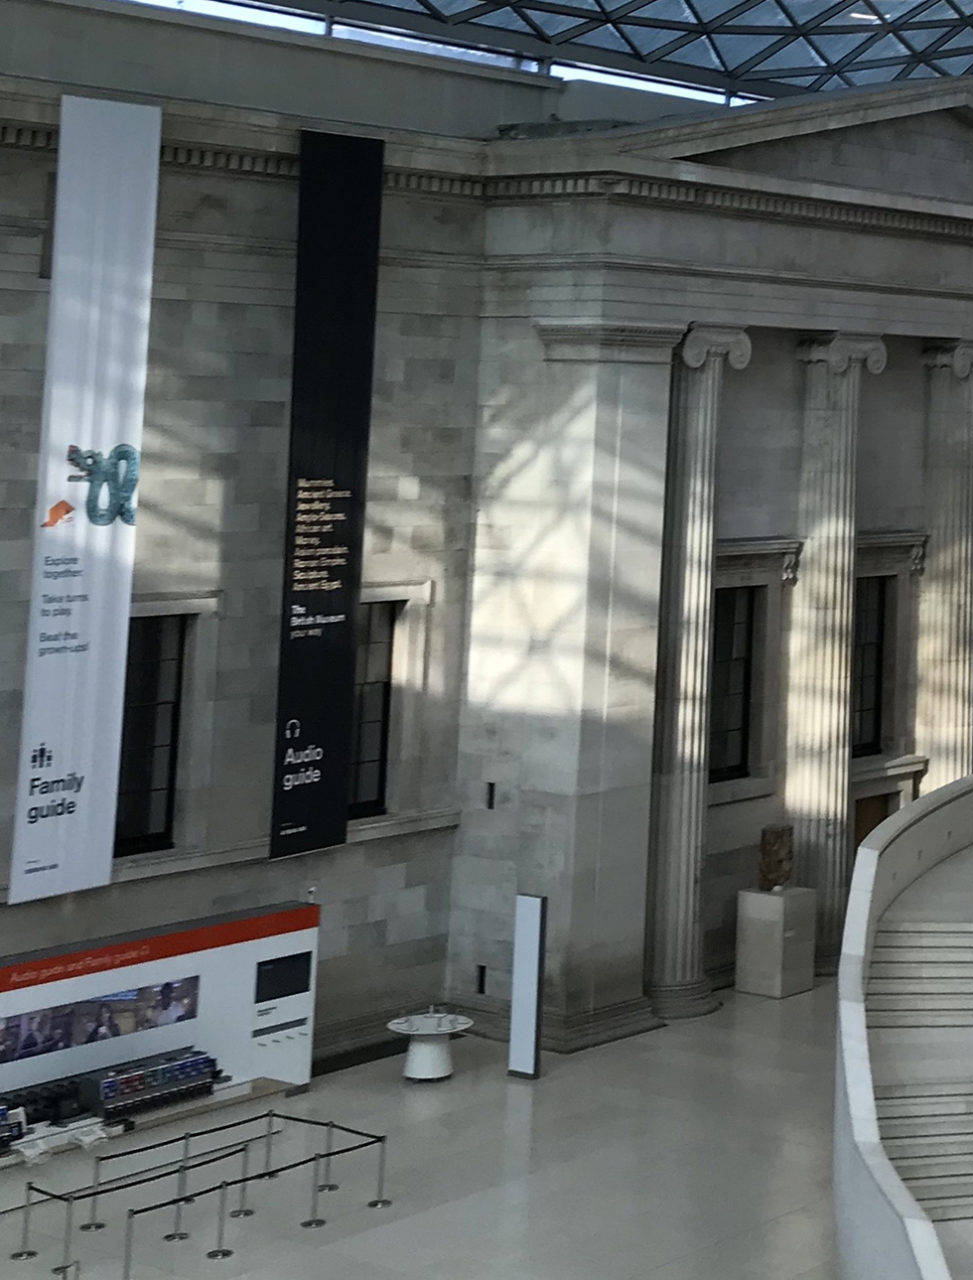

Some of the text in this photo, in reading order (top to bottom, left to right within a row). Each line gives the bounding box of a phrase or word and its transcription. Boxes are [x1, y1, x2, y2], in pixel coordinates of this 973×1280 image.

[44, 556, 79, 567] Explore
[41, 593, 88, 604] Take turns
[290, 605, 306, 615] The
[290, 614, 346, 626] British Museum
[40, 630, 79, 642] Beat the
[290, 630, 307, 640] your
[283, 744, 324, 766] Audio
[29, 772, 85, 796] Family
[282, 766, 322, 791] guide
[27, 797, 77, 824] guide
[10, 950, 139, 983] Audio guide and Family guide
